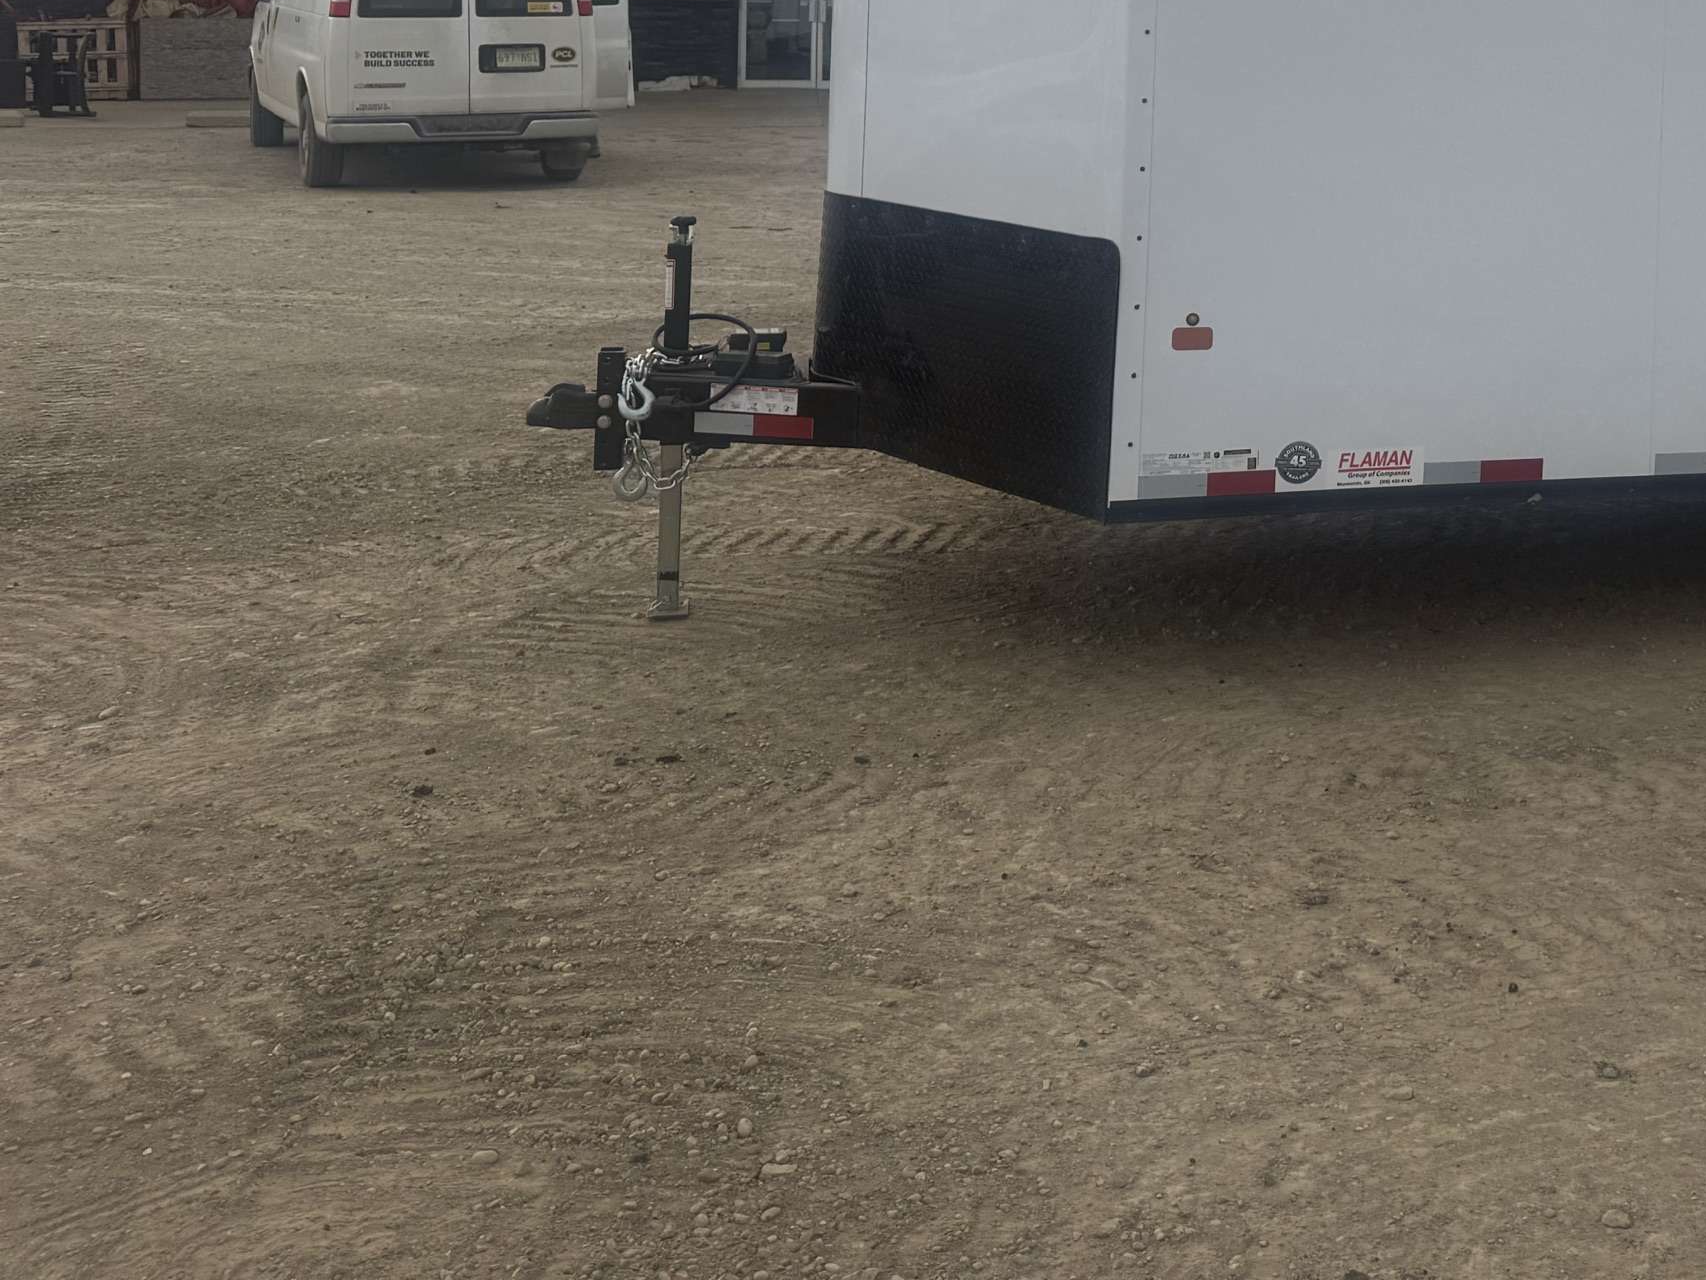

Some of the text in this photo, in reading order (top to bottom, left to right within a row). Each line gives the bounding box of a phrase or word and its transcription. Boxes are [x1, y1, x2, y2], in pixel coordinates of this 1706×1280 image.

[363, 50, 431, 59] TOGETHER WE
[554, 49, 575, 59] PCL
[363, 59, 435, 68] BUILD SUCCESS
[1290, 455, 1307, 468] 45
[1338, 449, 1413, 469] FLAMAN
[1347, 471, 1367, 479] Group
[1376, 470, 1410, 478] Companies
